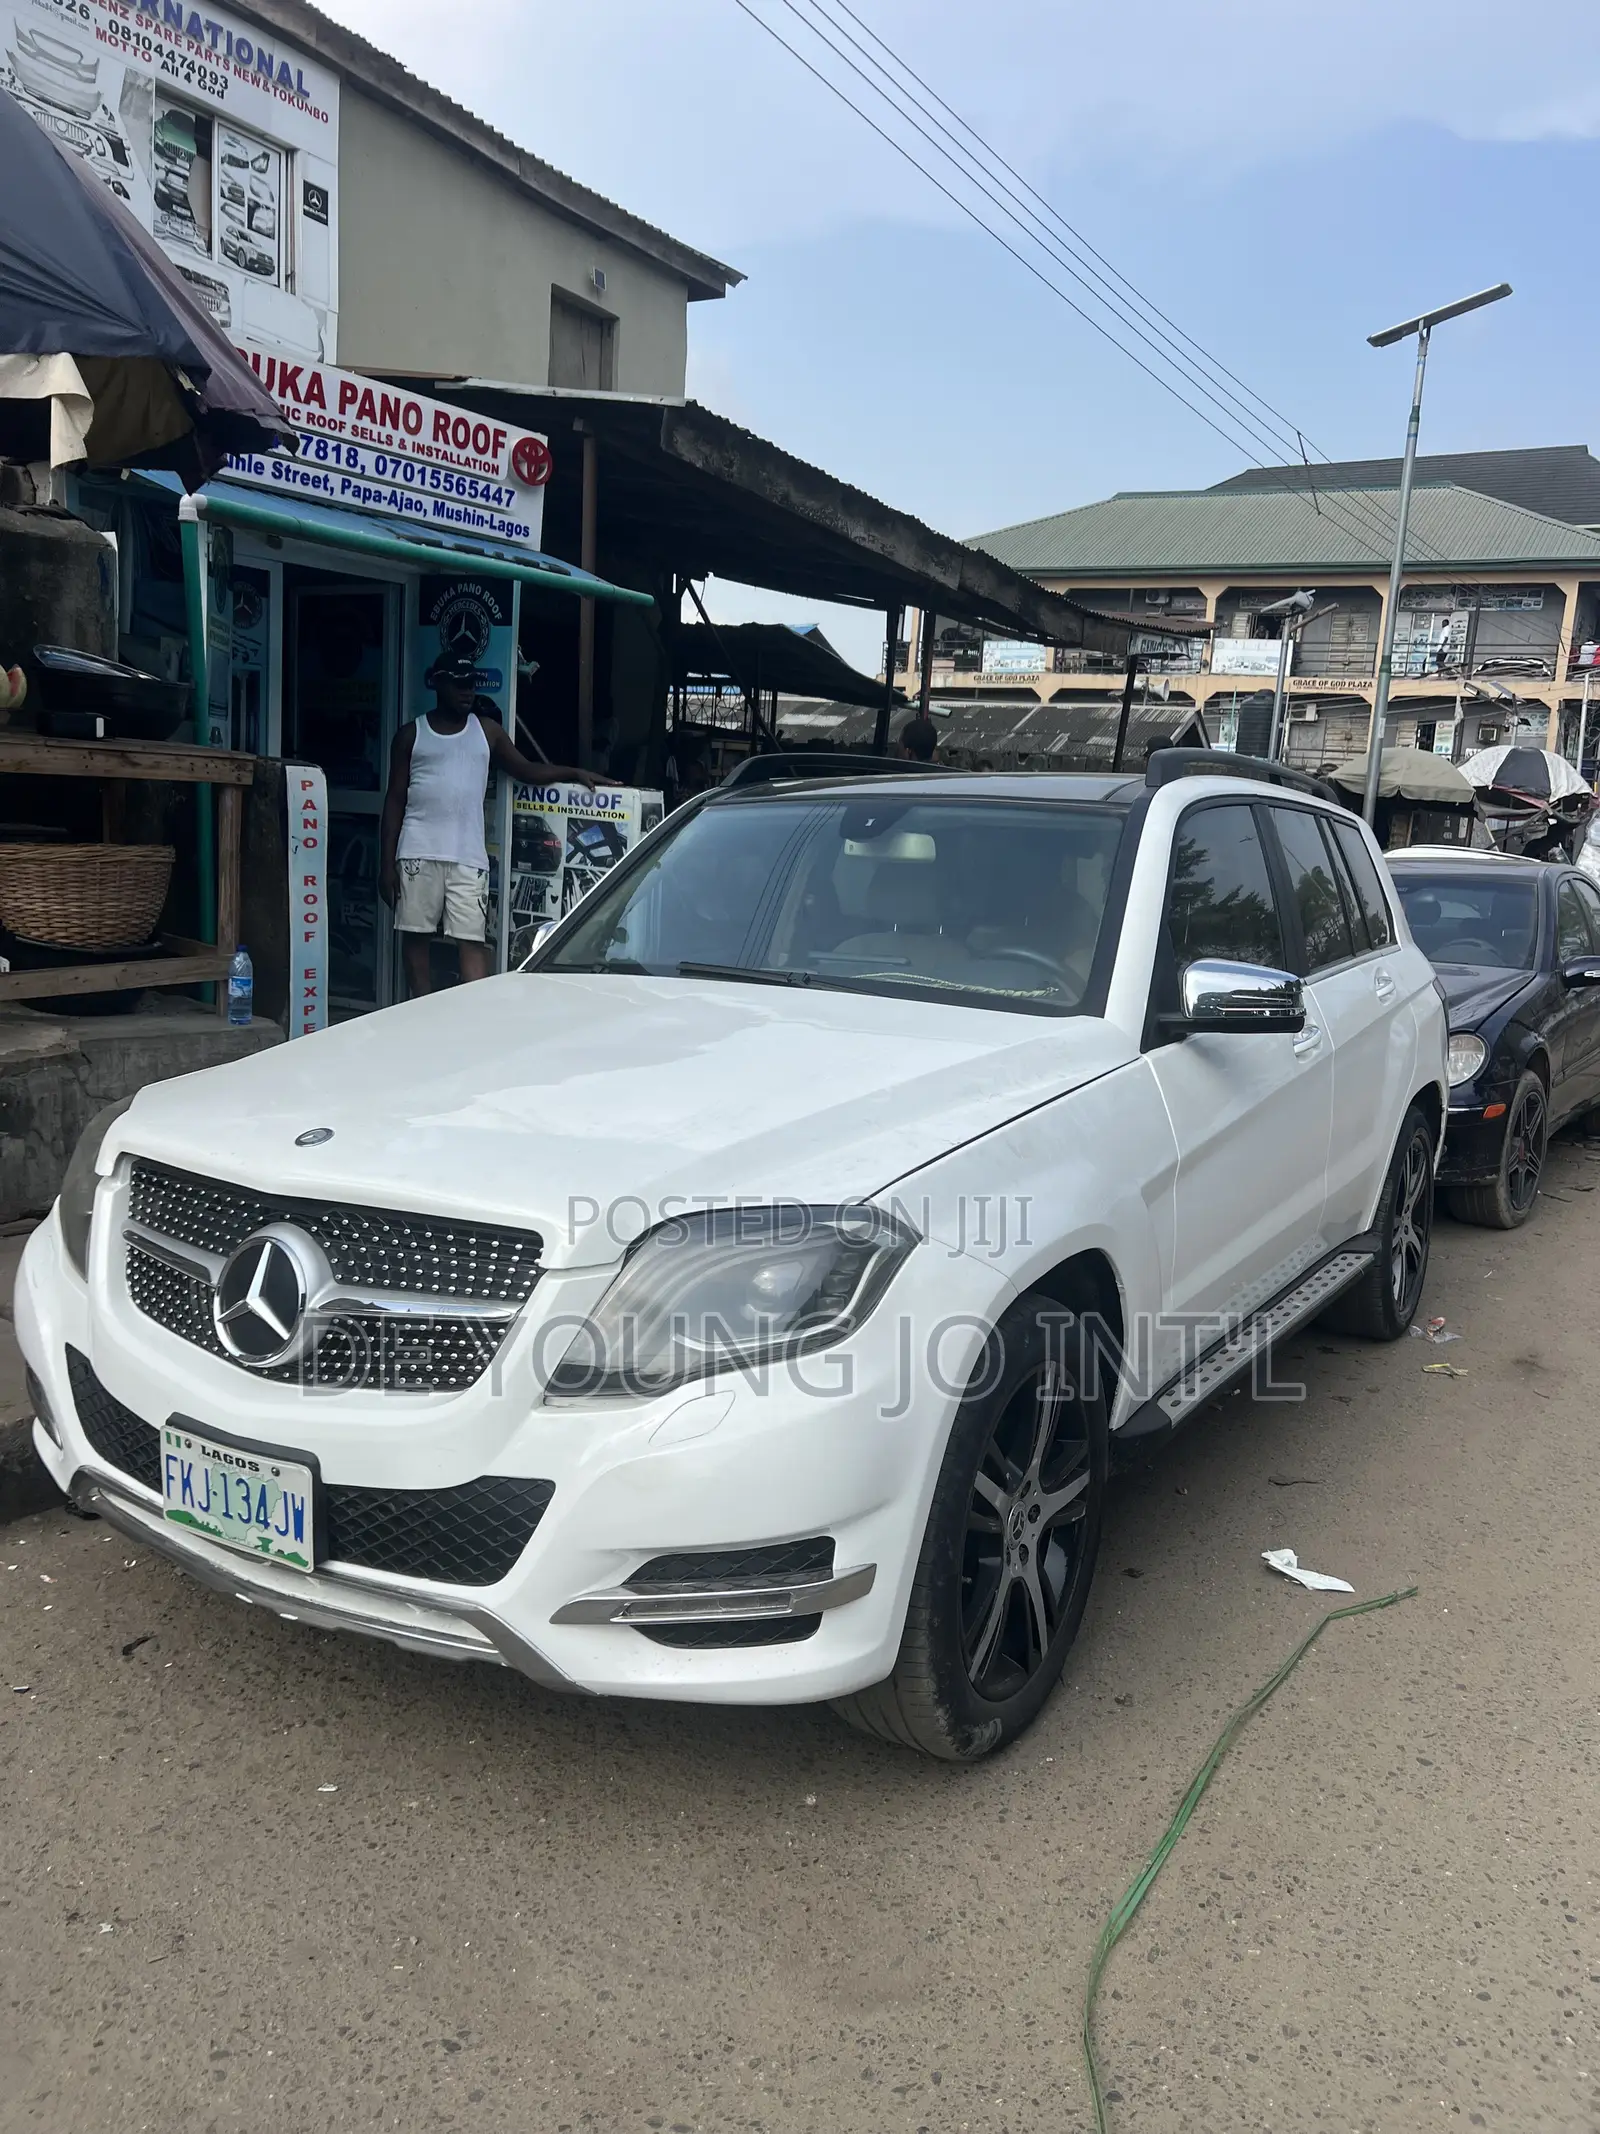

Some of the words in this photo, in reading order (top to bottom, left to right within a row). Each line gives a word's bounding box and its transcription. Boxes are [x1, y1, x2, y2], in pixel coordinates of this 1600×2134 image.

[95, 26, 152, 63] MOTTO
[160, 60, 179, 78] All
[184, 72, 192, 84] 4
[198, 79, 225, 100] God
[109, 19, 229, 90] 08104474093
[135, 13, 182, 47] SPARE
[187, 40, 230, 71] PARTS
[236, 347, 327, 410] UKA
[338, 379, 423, 436] PANO
[432, 409, 508, 460] ROOF
[306, 411, 347, 433] ROOF
[351, 424, 393, 447] SELLS
[398, 438, 407, 450] &
[412, 441, 500, 476] INSTALLATION
[271, 460, 336, 496] Street,
[340, 476, 428, 518] Papa-Ajao,
[432, 500, 531, 538] Mushin-Lagos
[375, 454, 516, 509] 07015565447
[430, 586, 456, 621] EBUKA
[457, 582, 482, 596] PANO
[482, 590, 503, 620] ROOF
[1292, 679, 1317, 687] GRACE
[1330, 680, 1346, 688] GOD
[300, 780, 318, 849] PANO
[516, 802, 545, 812] SELLS
[547, 804, 555, 812] &
[557, 806, 625, 820] INSTALLATION
[567, 789, 623, 810] ROOF
[303, 875, 318, 943] ROOF
[200, 1444, 260, 1473] LAGOS
[165, 1453, 305, 1544] FKJ-134JW
